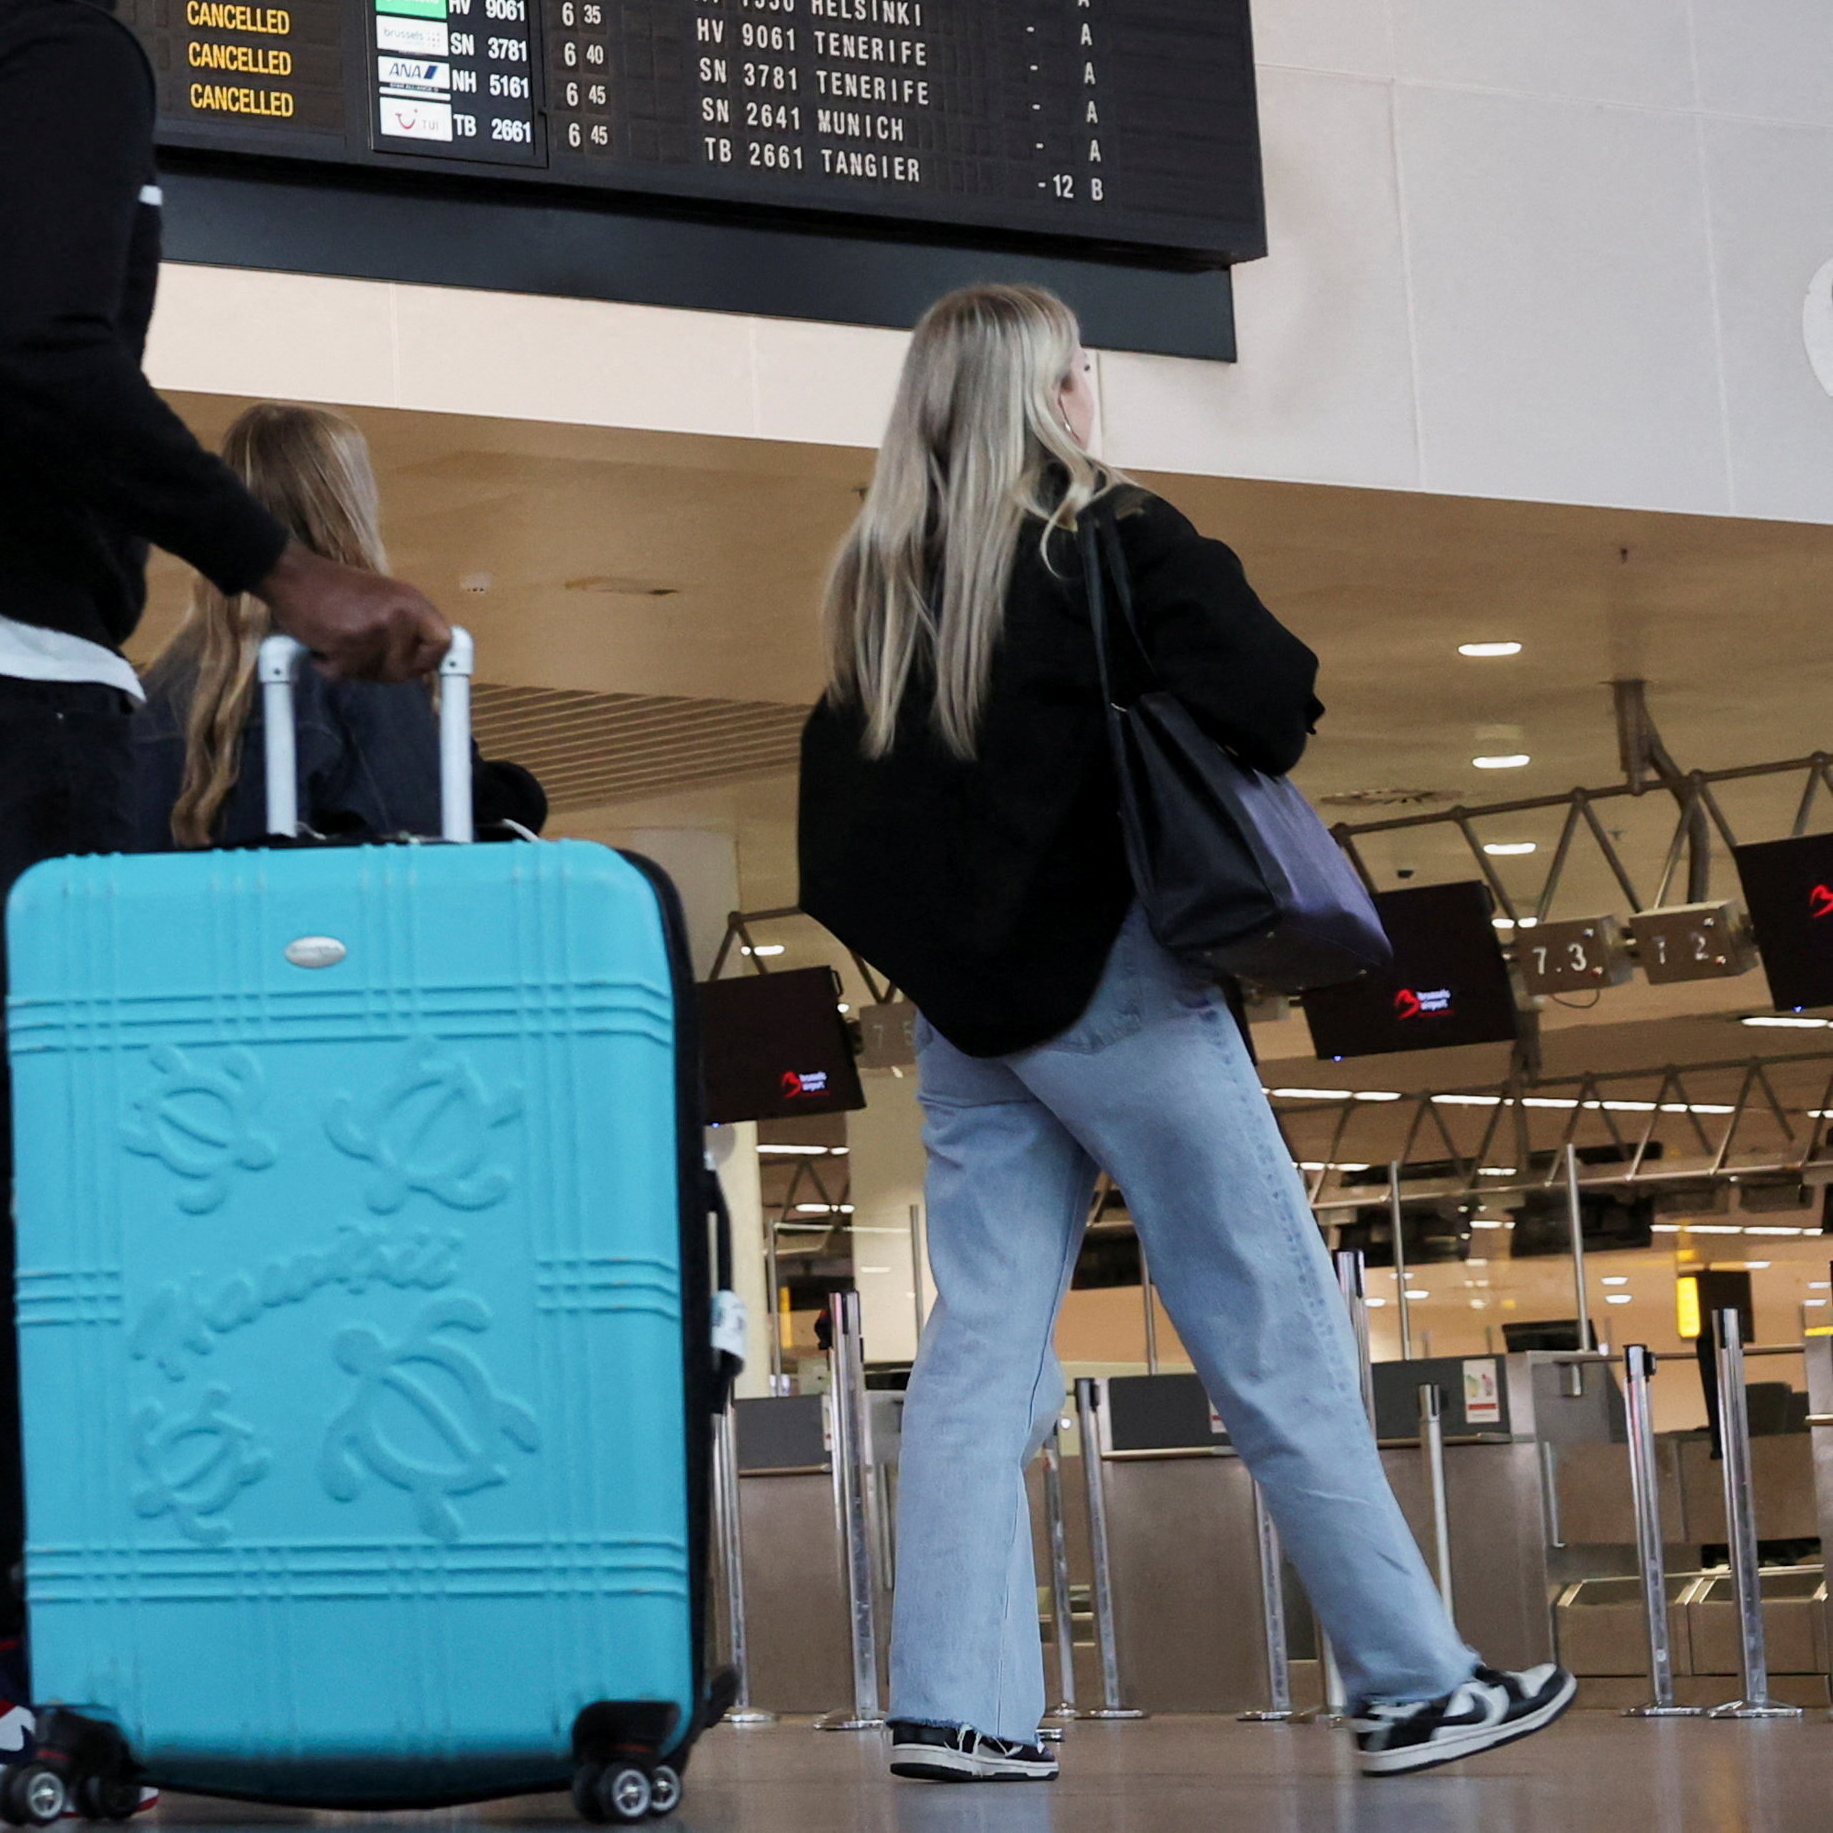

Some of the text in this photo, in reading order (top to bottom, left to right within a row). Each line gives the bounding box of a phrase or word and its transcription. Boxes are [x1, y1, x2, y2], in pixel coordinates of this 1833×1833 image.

[814, 31, 926, 65] TENERIFE
[191, 84, 293, 116] CANCELLED
[818, 109, 903, 141] MUNICH
